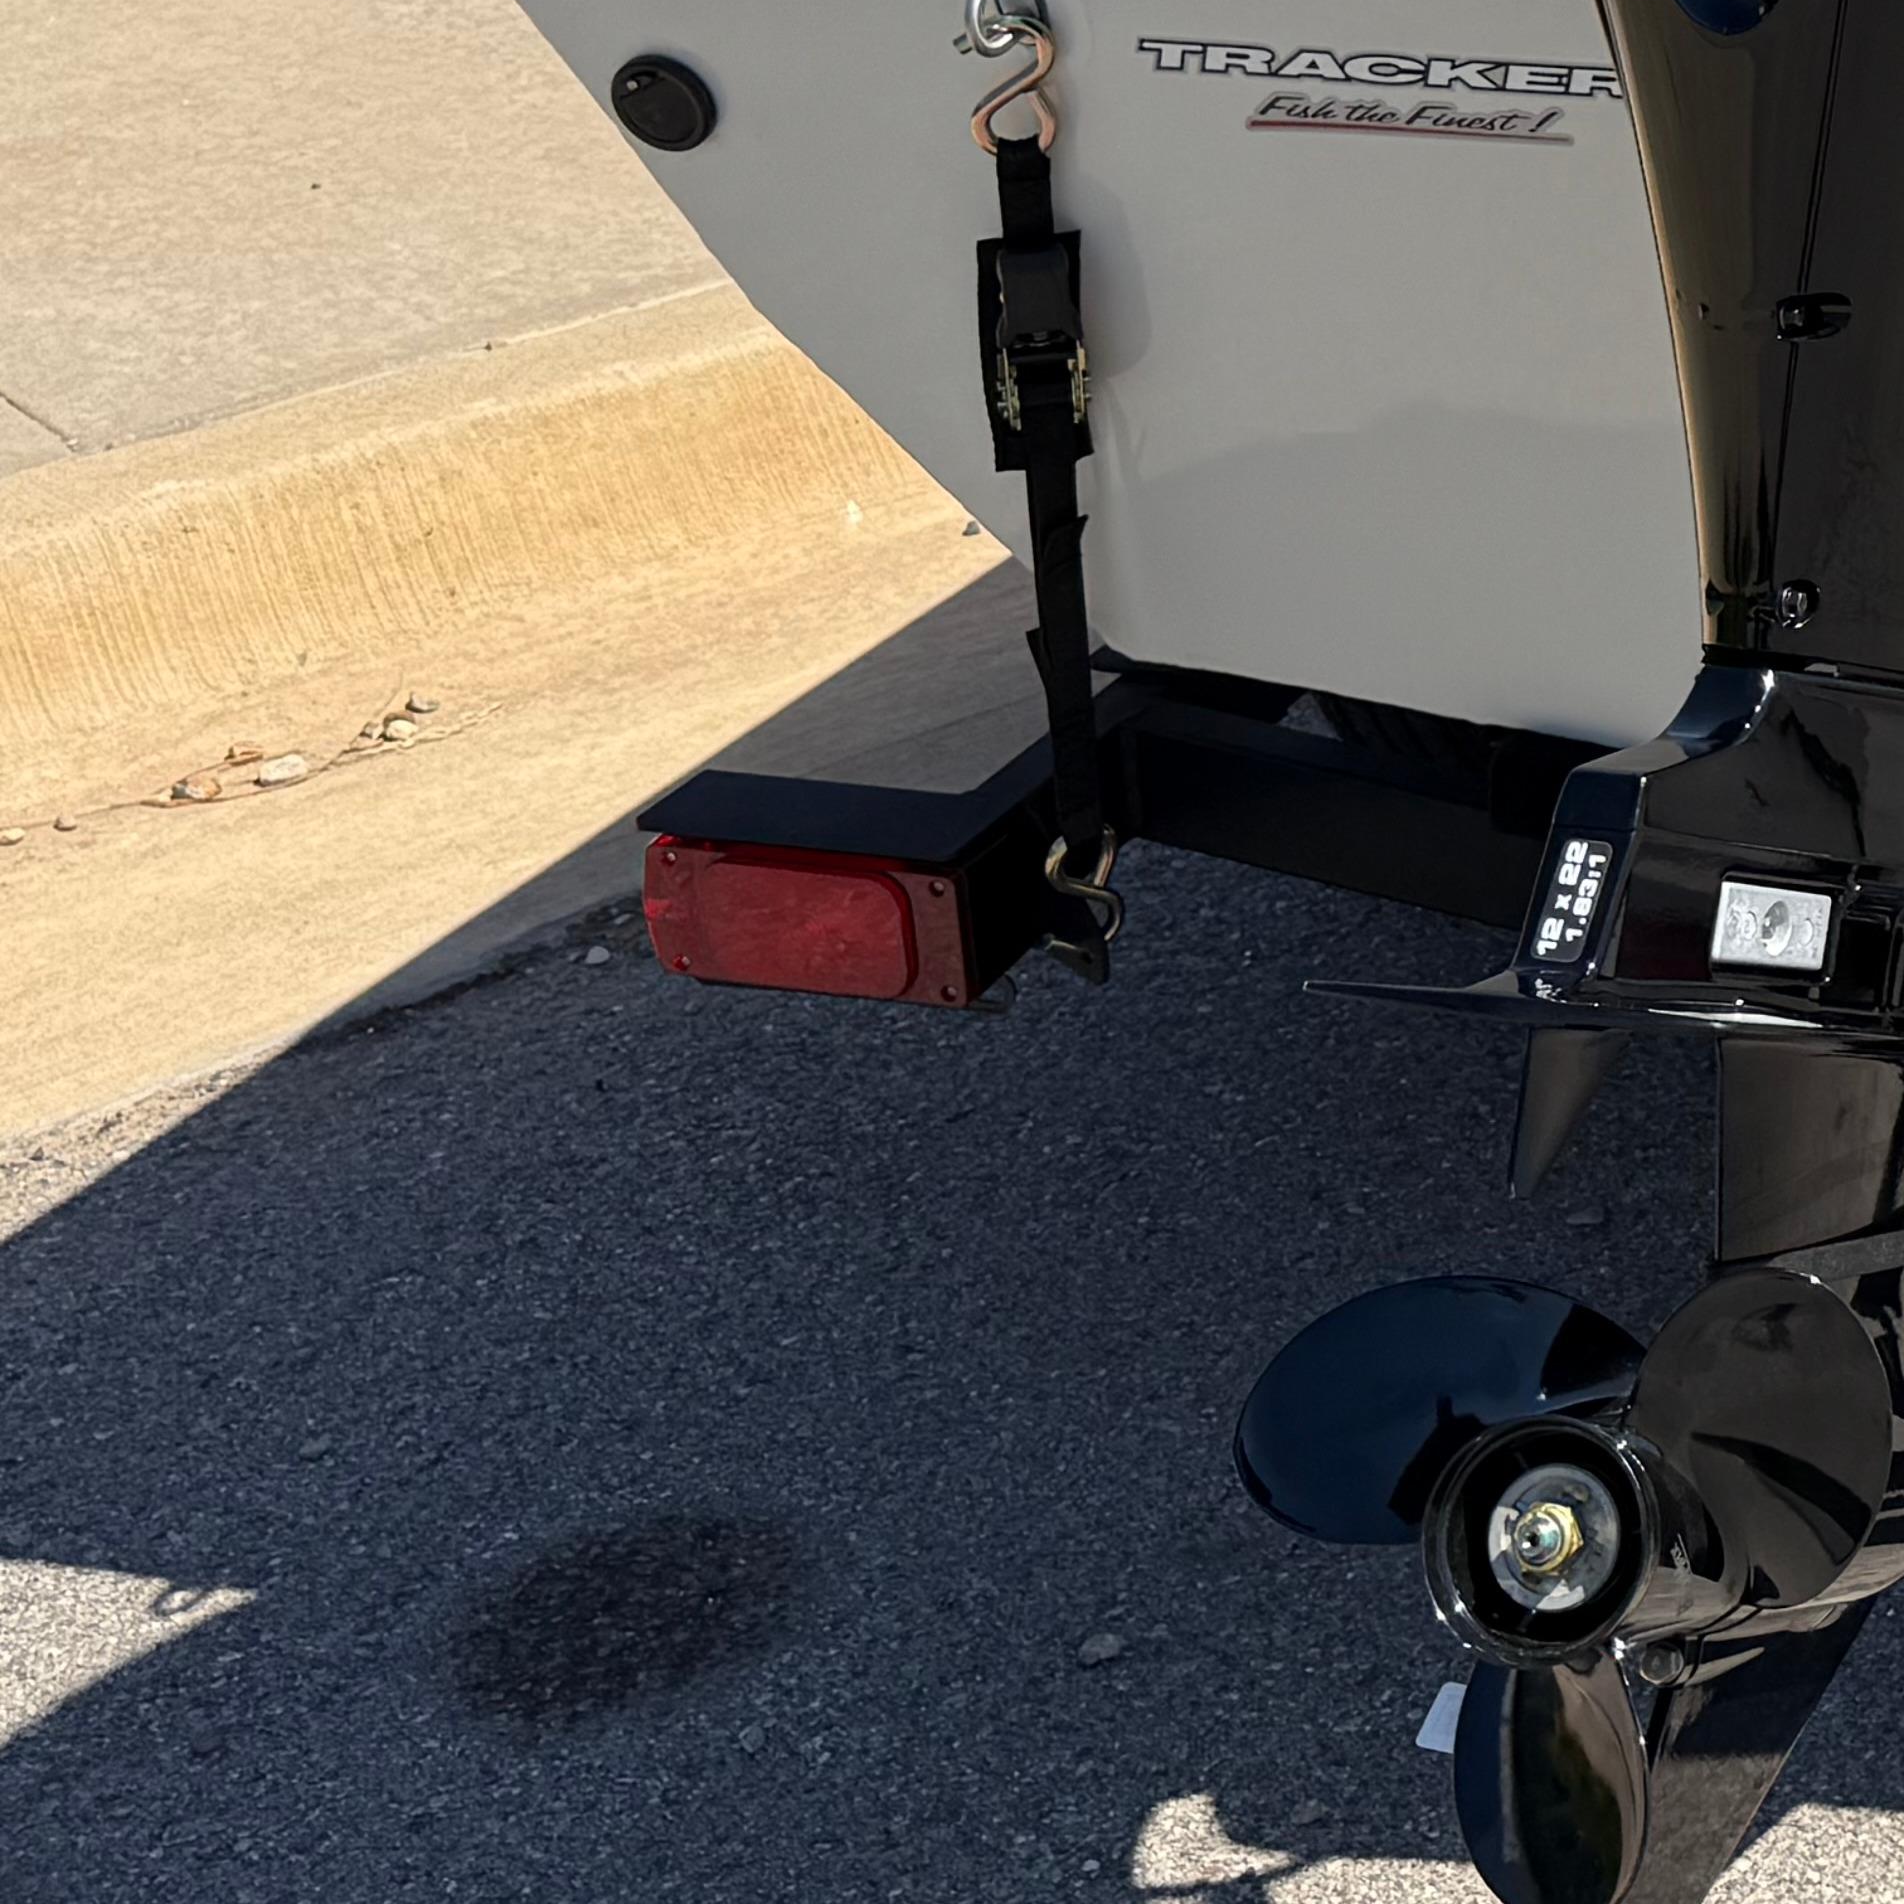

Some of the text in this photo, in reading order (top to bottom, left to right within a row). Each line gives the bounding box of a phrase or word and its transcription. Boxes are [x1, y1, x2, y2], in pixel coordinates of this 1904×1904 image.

[1138, 37, 1625, 98] TRACKER
[1257, 95, 1339, 120] Fish
[1345, 101, 1398, 124] the
[1403, 104, 1518, 133] Finest
[1558, 842, 1588, 886] 22
[1554, 894, 1572, 911] x
[1565, 854, 1607, 942] 1.83:1
[1536, 917, 1564, 956] 12
